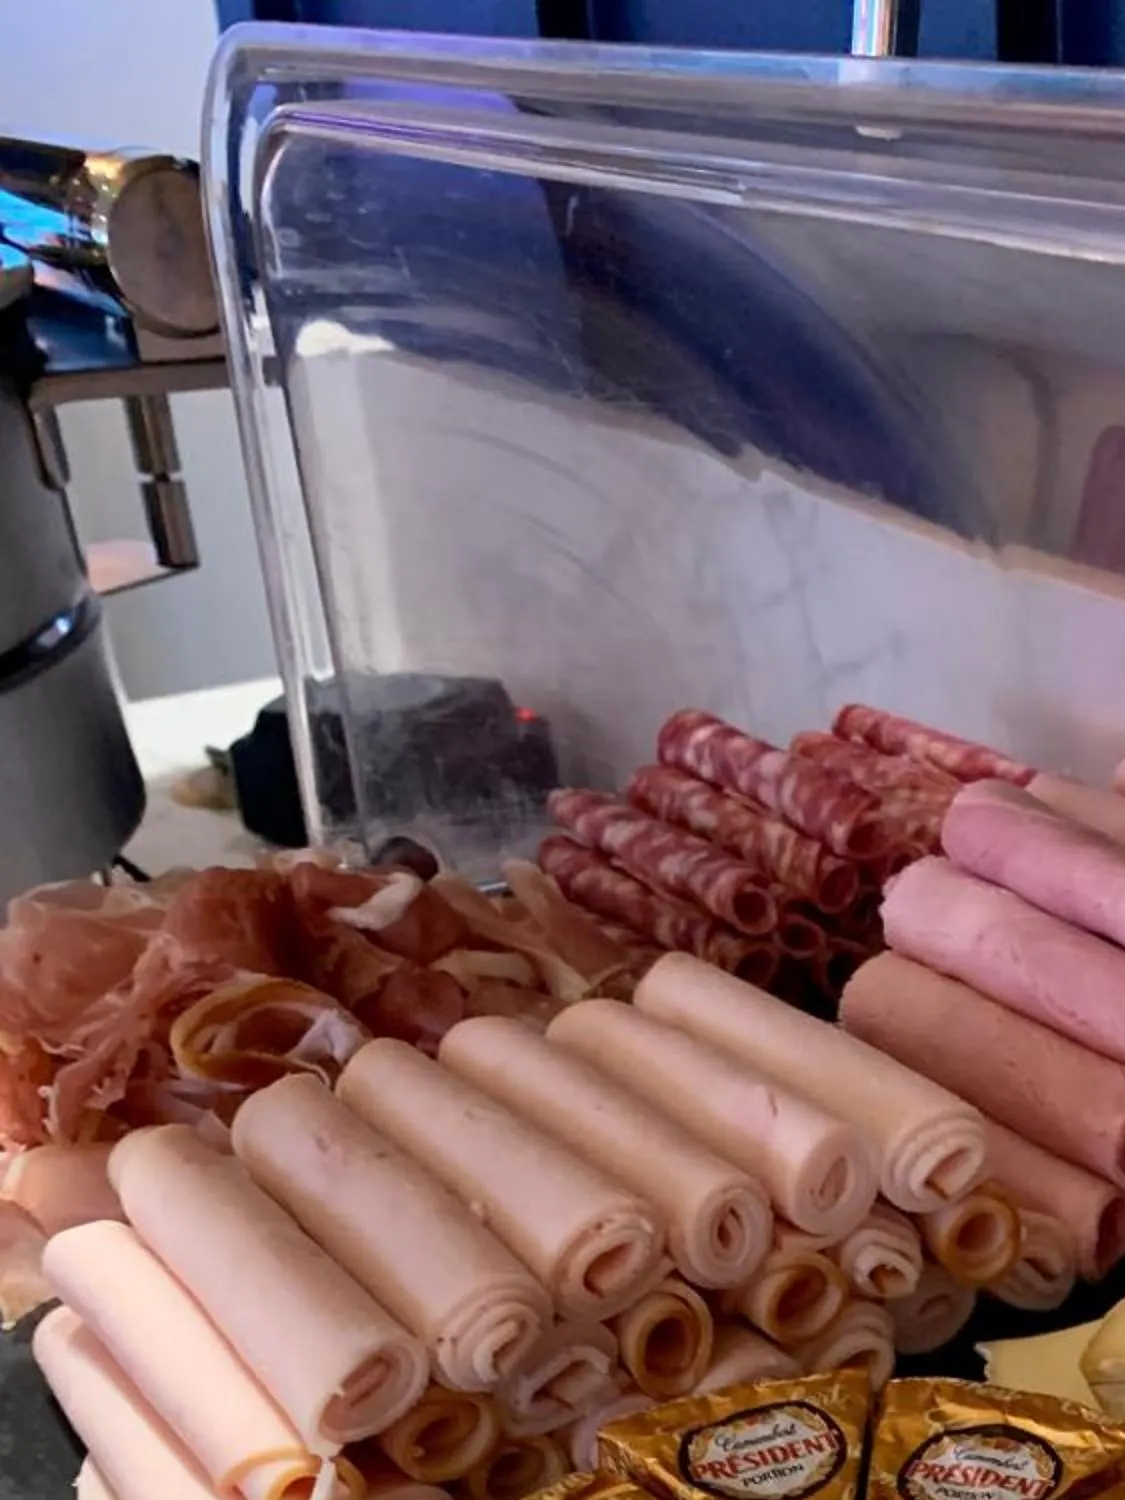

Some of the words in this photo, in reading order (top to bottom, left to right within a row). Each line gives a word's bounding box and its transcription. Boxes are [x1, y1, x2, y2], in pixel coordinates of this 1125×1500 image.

[714, 1424, 798, 1452] Camembert
[692, 1430, 841, 1480] PRÉSIDENT
[742, 1464, 805, 1488] PORTION
[908, 1460, 1054, 1499] PRÉSIDENT
